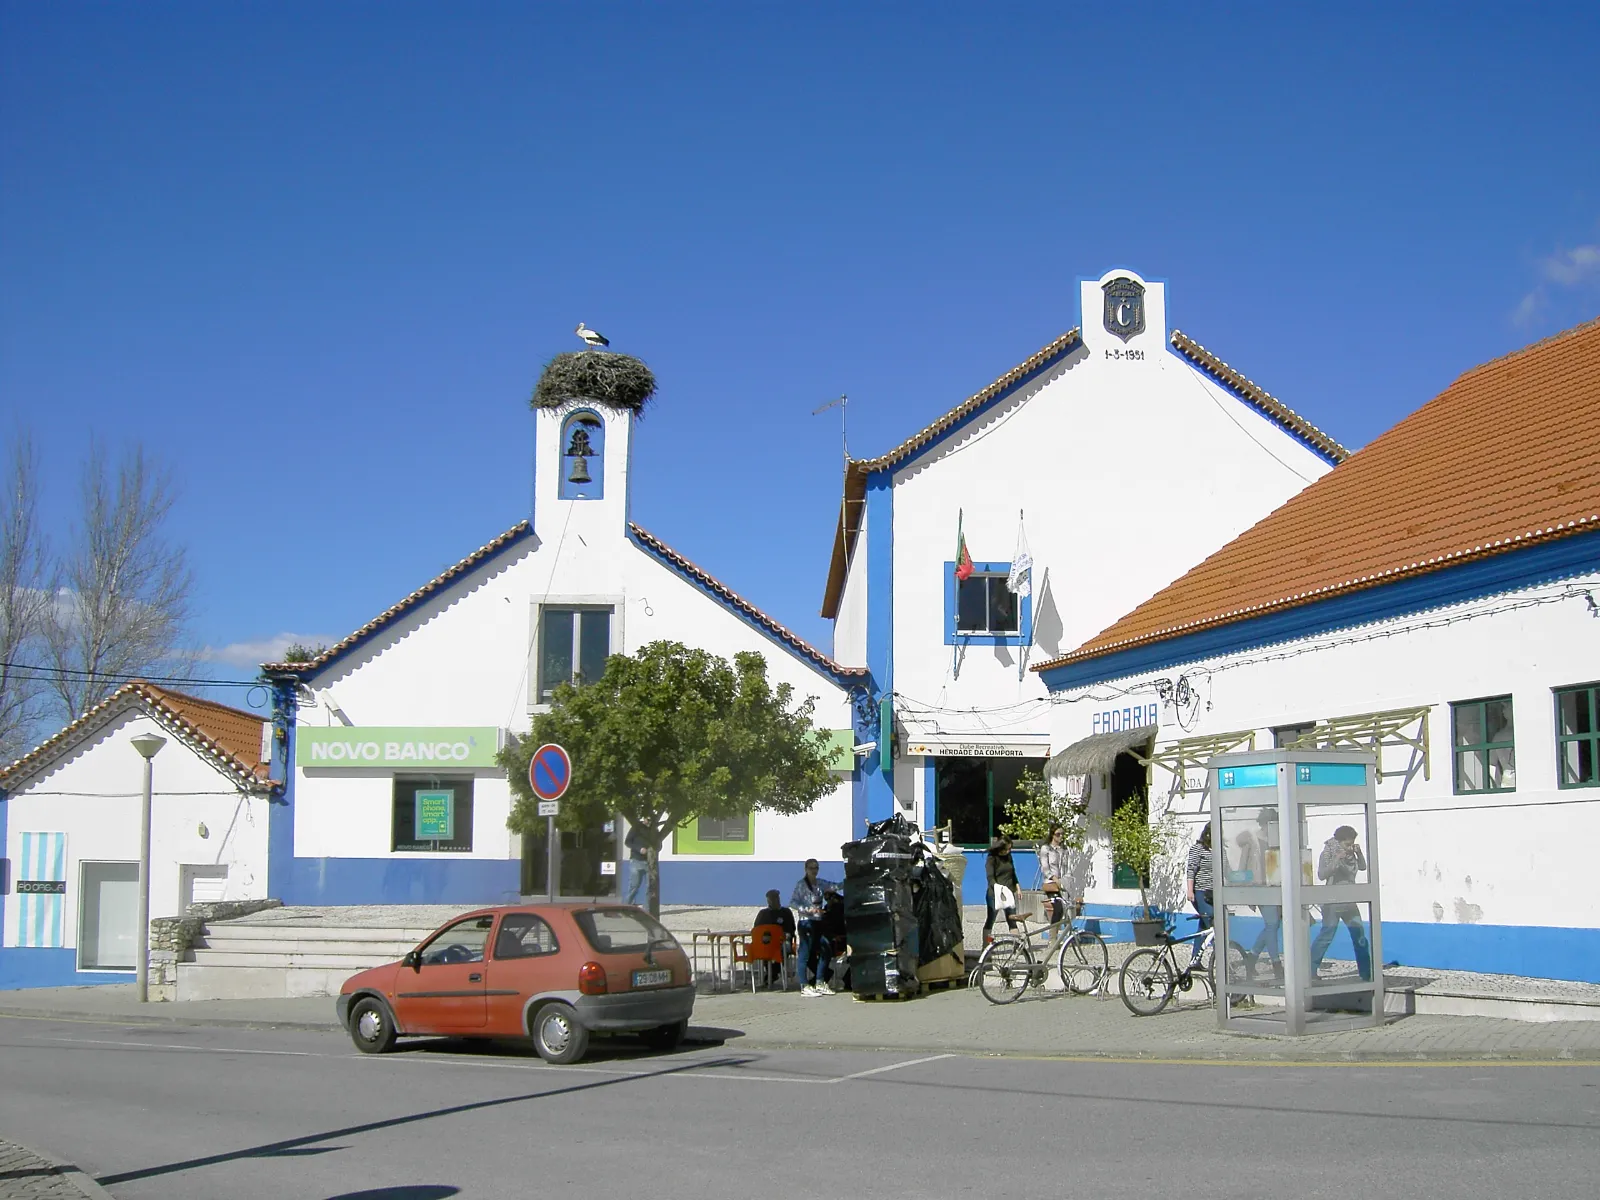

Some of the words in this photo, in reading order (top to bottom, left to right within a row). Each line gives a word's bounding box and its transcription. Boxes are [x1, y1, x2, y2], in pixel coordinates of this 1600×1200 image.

[1092, 703, 1158, 736] PADARIA
[311, 741, 381, 760] NOVO
[384, 741, 471, 761] BANCO
